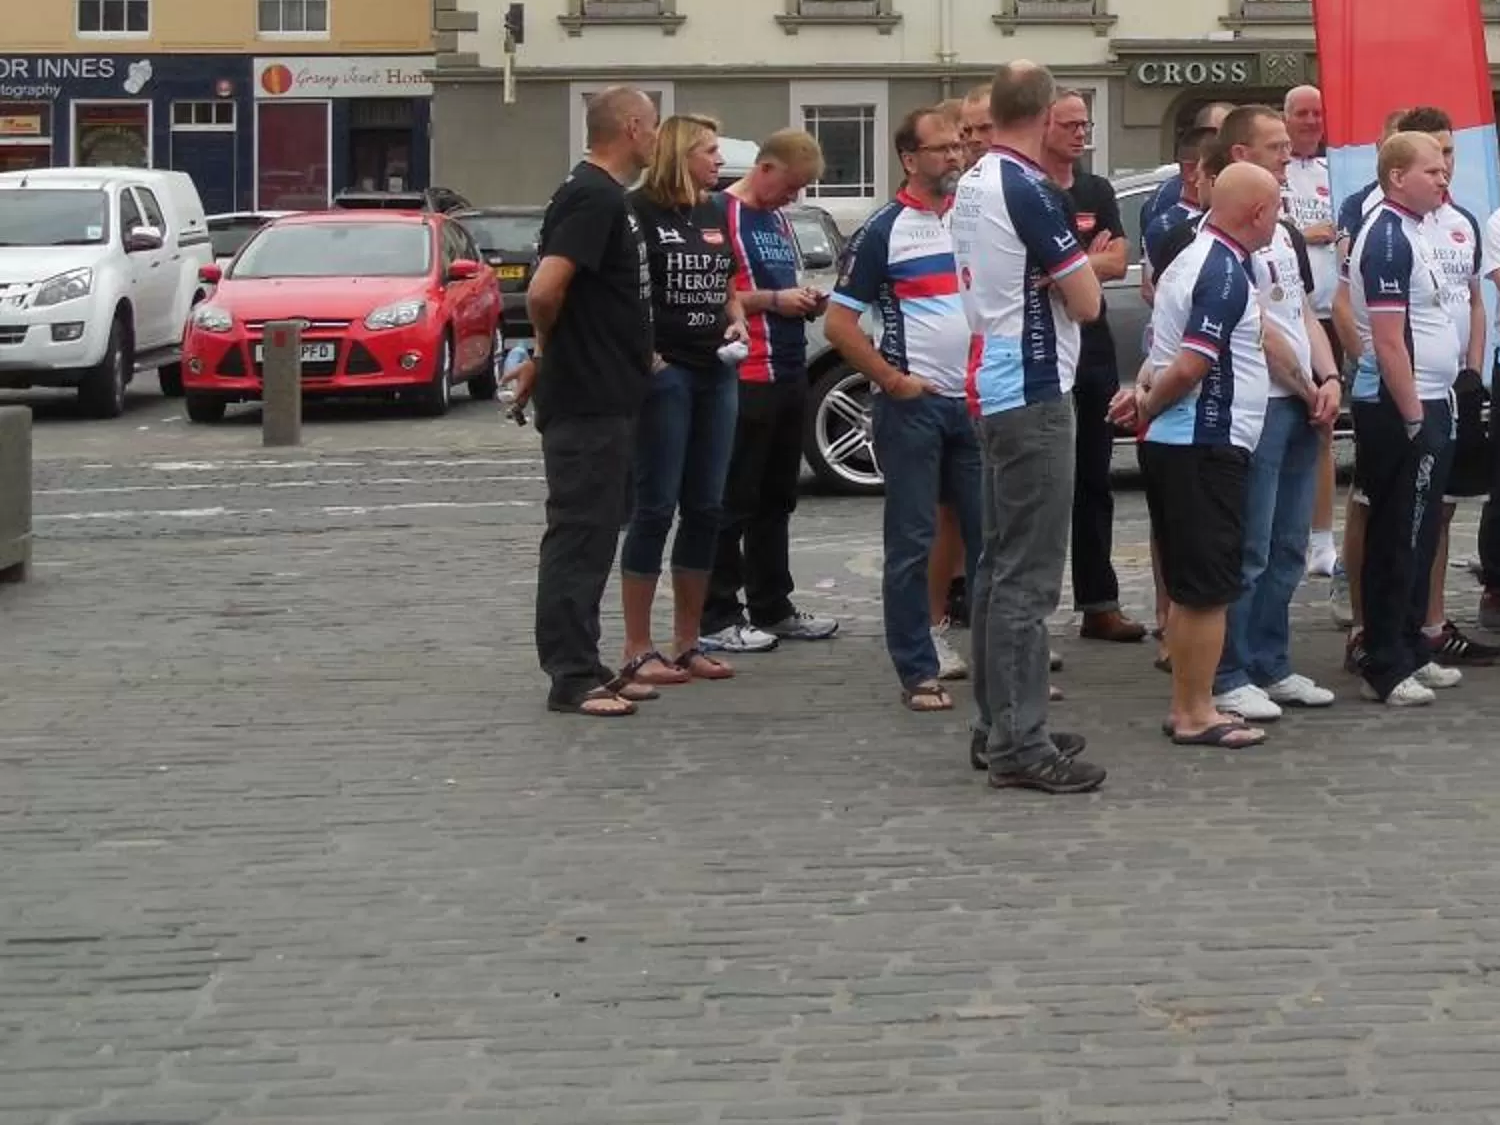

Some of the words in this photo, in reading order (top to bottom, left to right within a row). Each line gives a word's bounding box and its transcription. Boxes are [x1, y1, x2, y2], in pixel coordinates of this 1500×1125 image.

[37, 58, 115, 79] INNES
[1137, 61, 1248, 84] CROSS
[667, 252, 711, 271] HELP
[711, 254, 731, 273] for
[667, 272, 727, 290] HEROES
